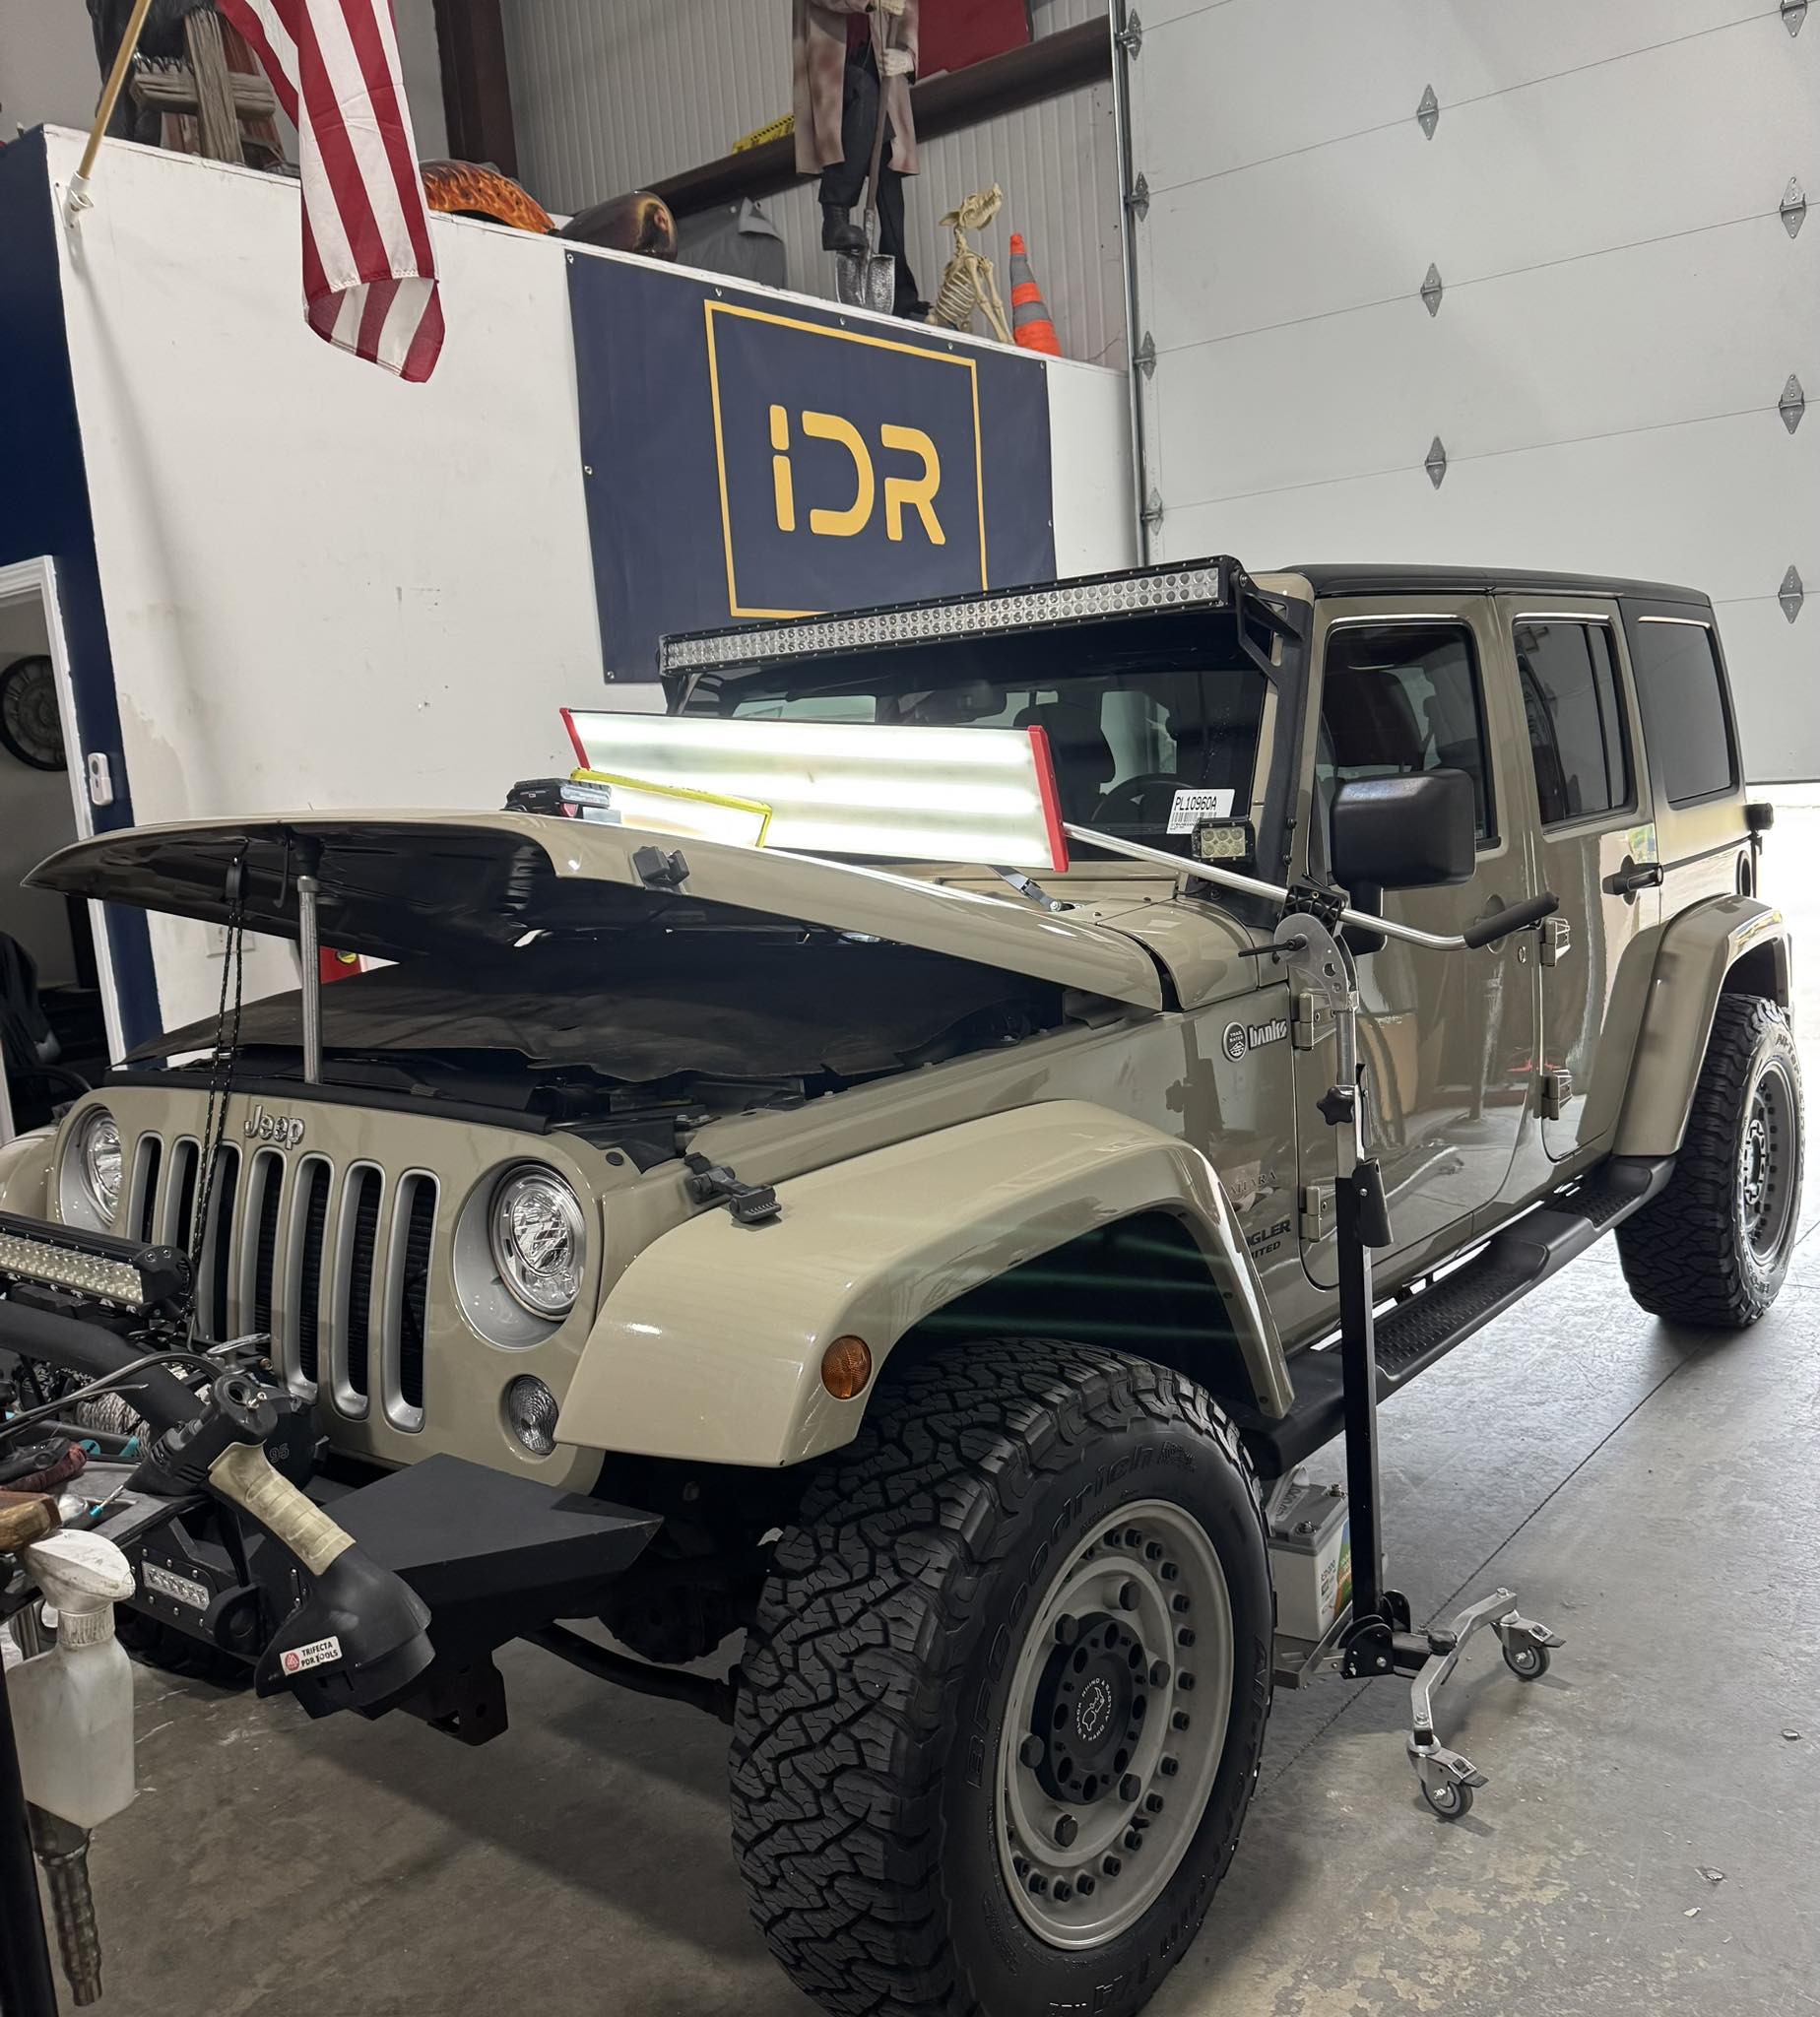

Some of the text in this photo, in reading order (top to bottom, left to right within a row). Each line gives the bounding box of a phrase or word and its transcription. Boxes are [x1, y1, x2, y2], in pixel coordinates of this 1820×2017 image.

[1173, 796, 1217, 812] PL10960A
[1248, 1019, 1287, 1050] banks
[244, 1104, 305, 1150] Jeep
[301, 1642, 333, 1657] TRIFECTA
[300, 1657, 316, 1667] PDR
